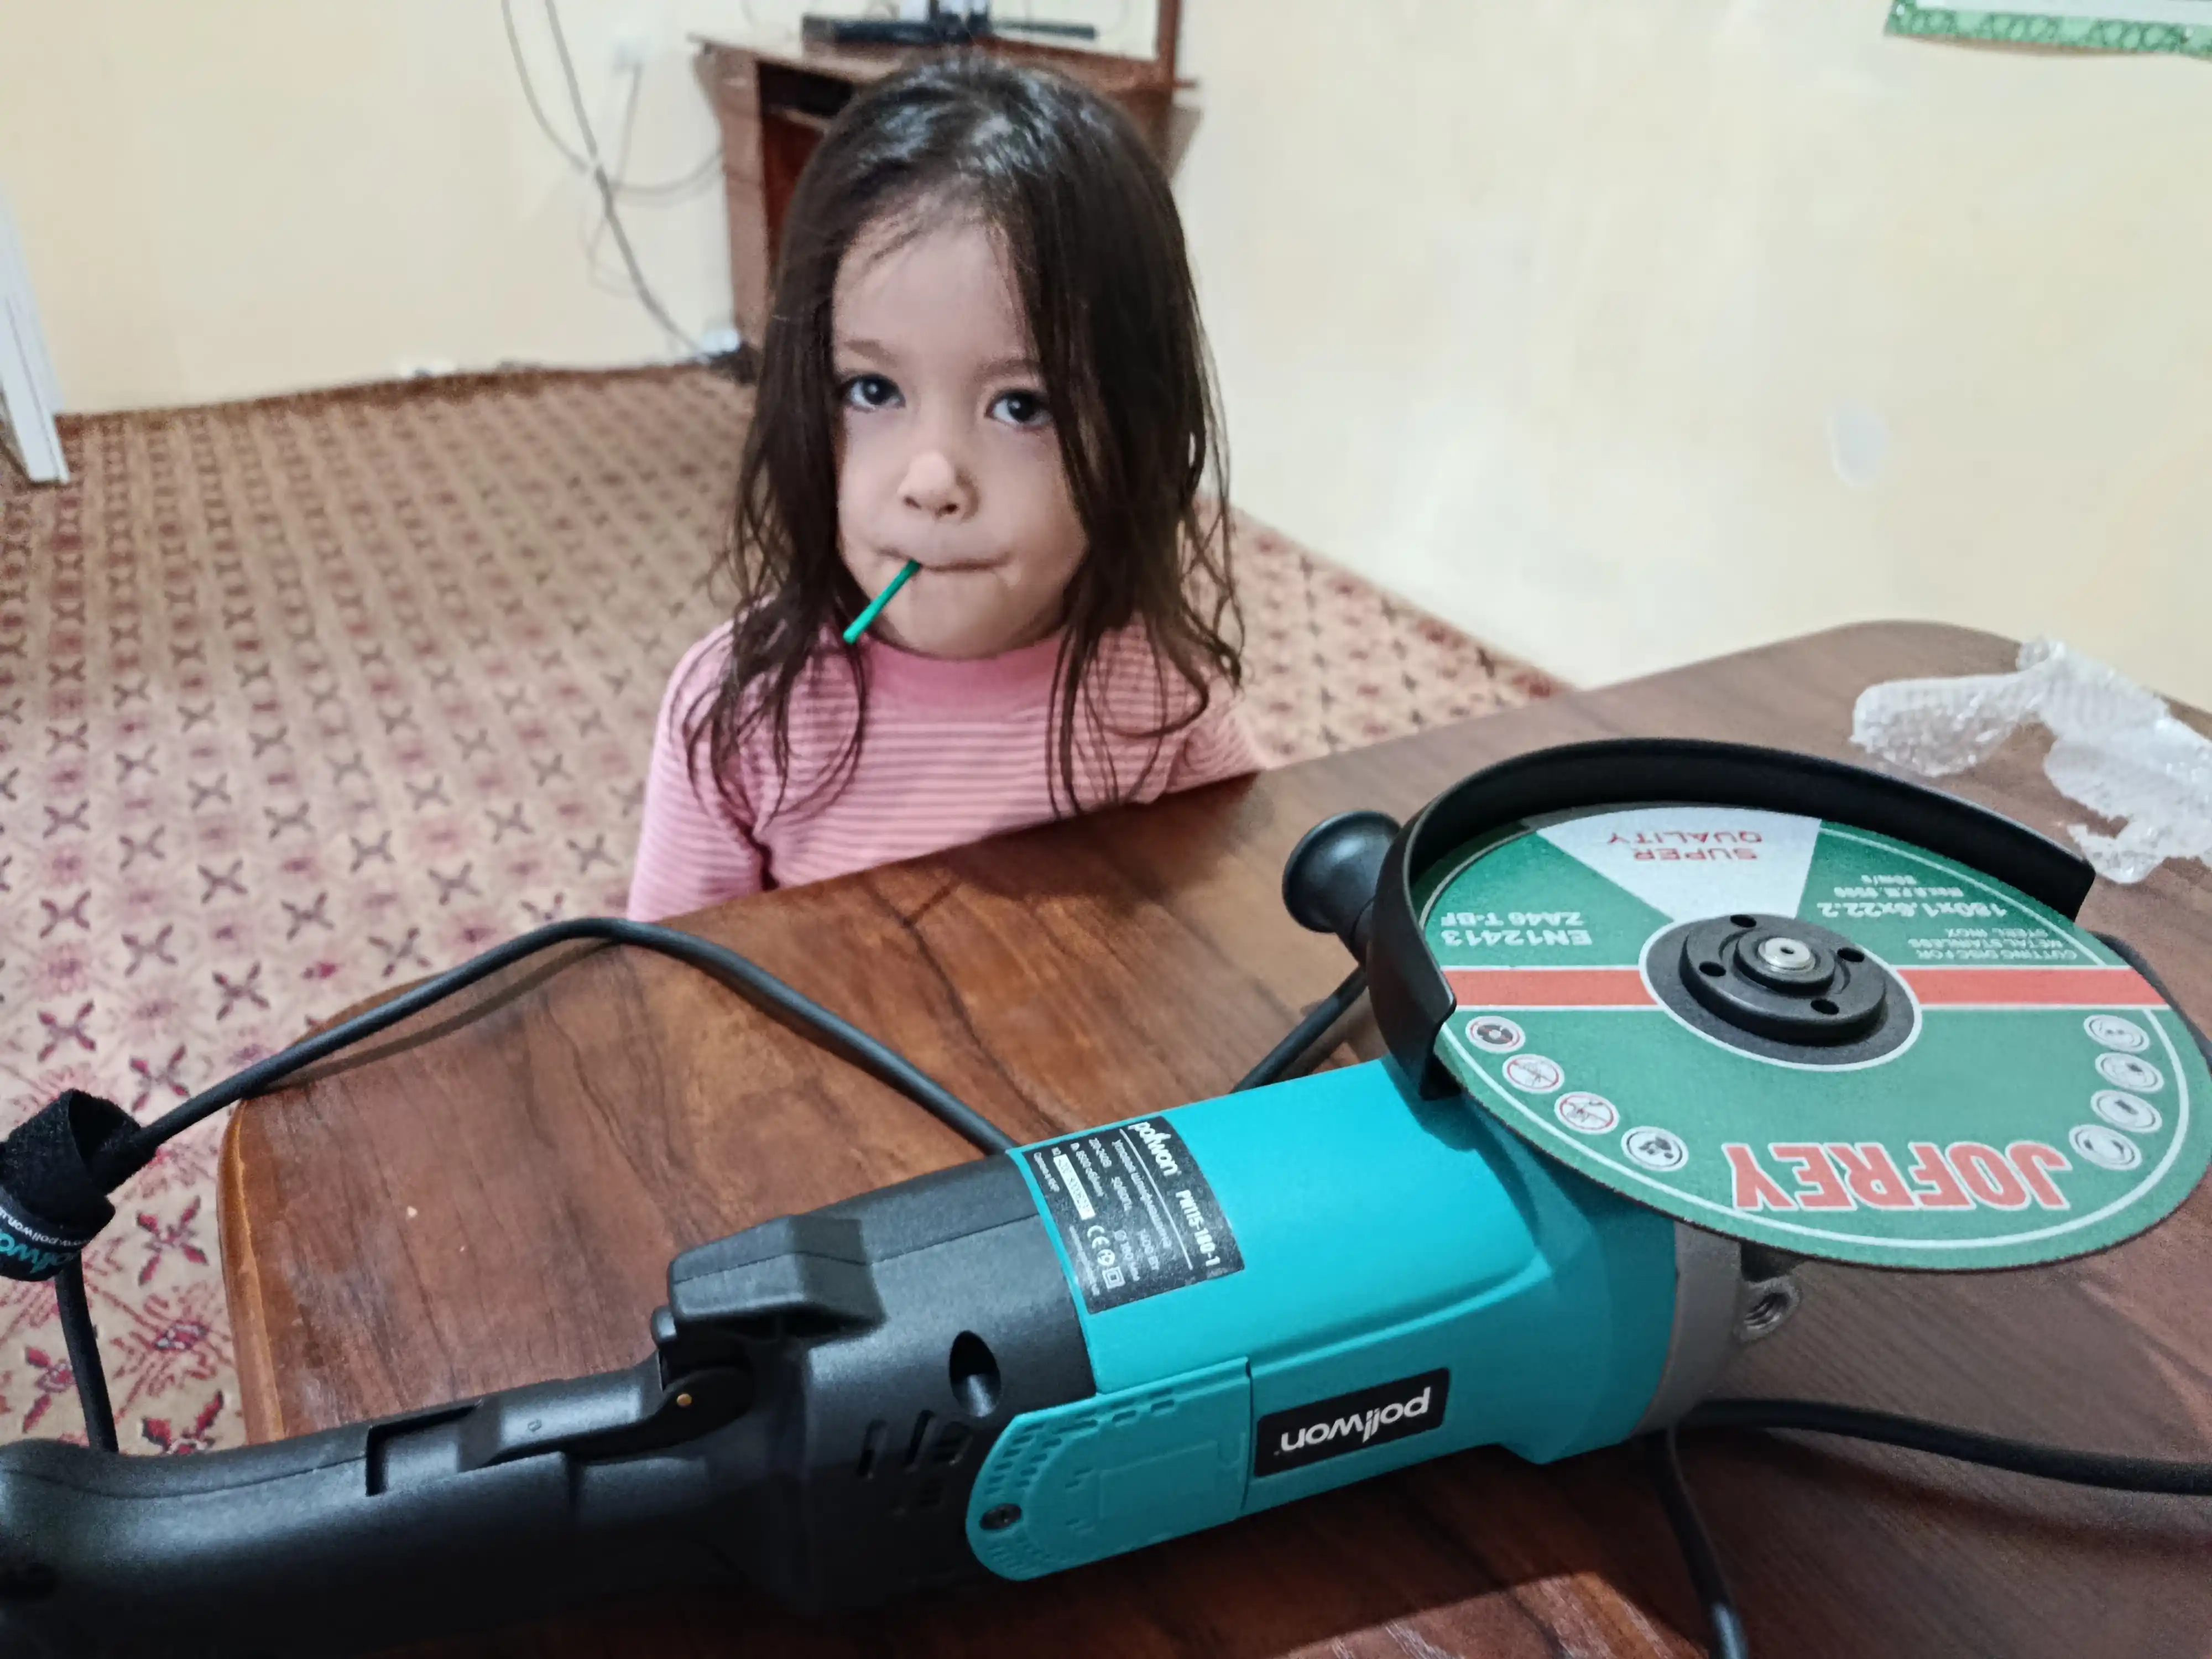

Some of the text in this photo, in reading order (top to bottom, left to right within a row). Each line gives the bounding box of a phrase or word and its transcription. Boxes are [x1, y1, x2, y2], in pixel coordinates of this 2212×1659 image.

[1605, 831, 1762, 844] QUALITY
[1631, 848, 1757, 859] SUPER
[1439, 929, 1593, 946] EN12413
[1128, 1121, 1181, 1176] pollwon
[1720, 1141, 2072, 1211] JOFREY
[1280, 1386, 1431, 1443] pollwon
